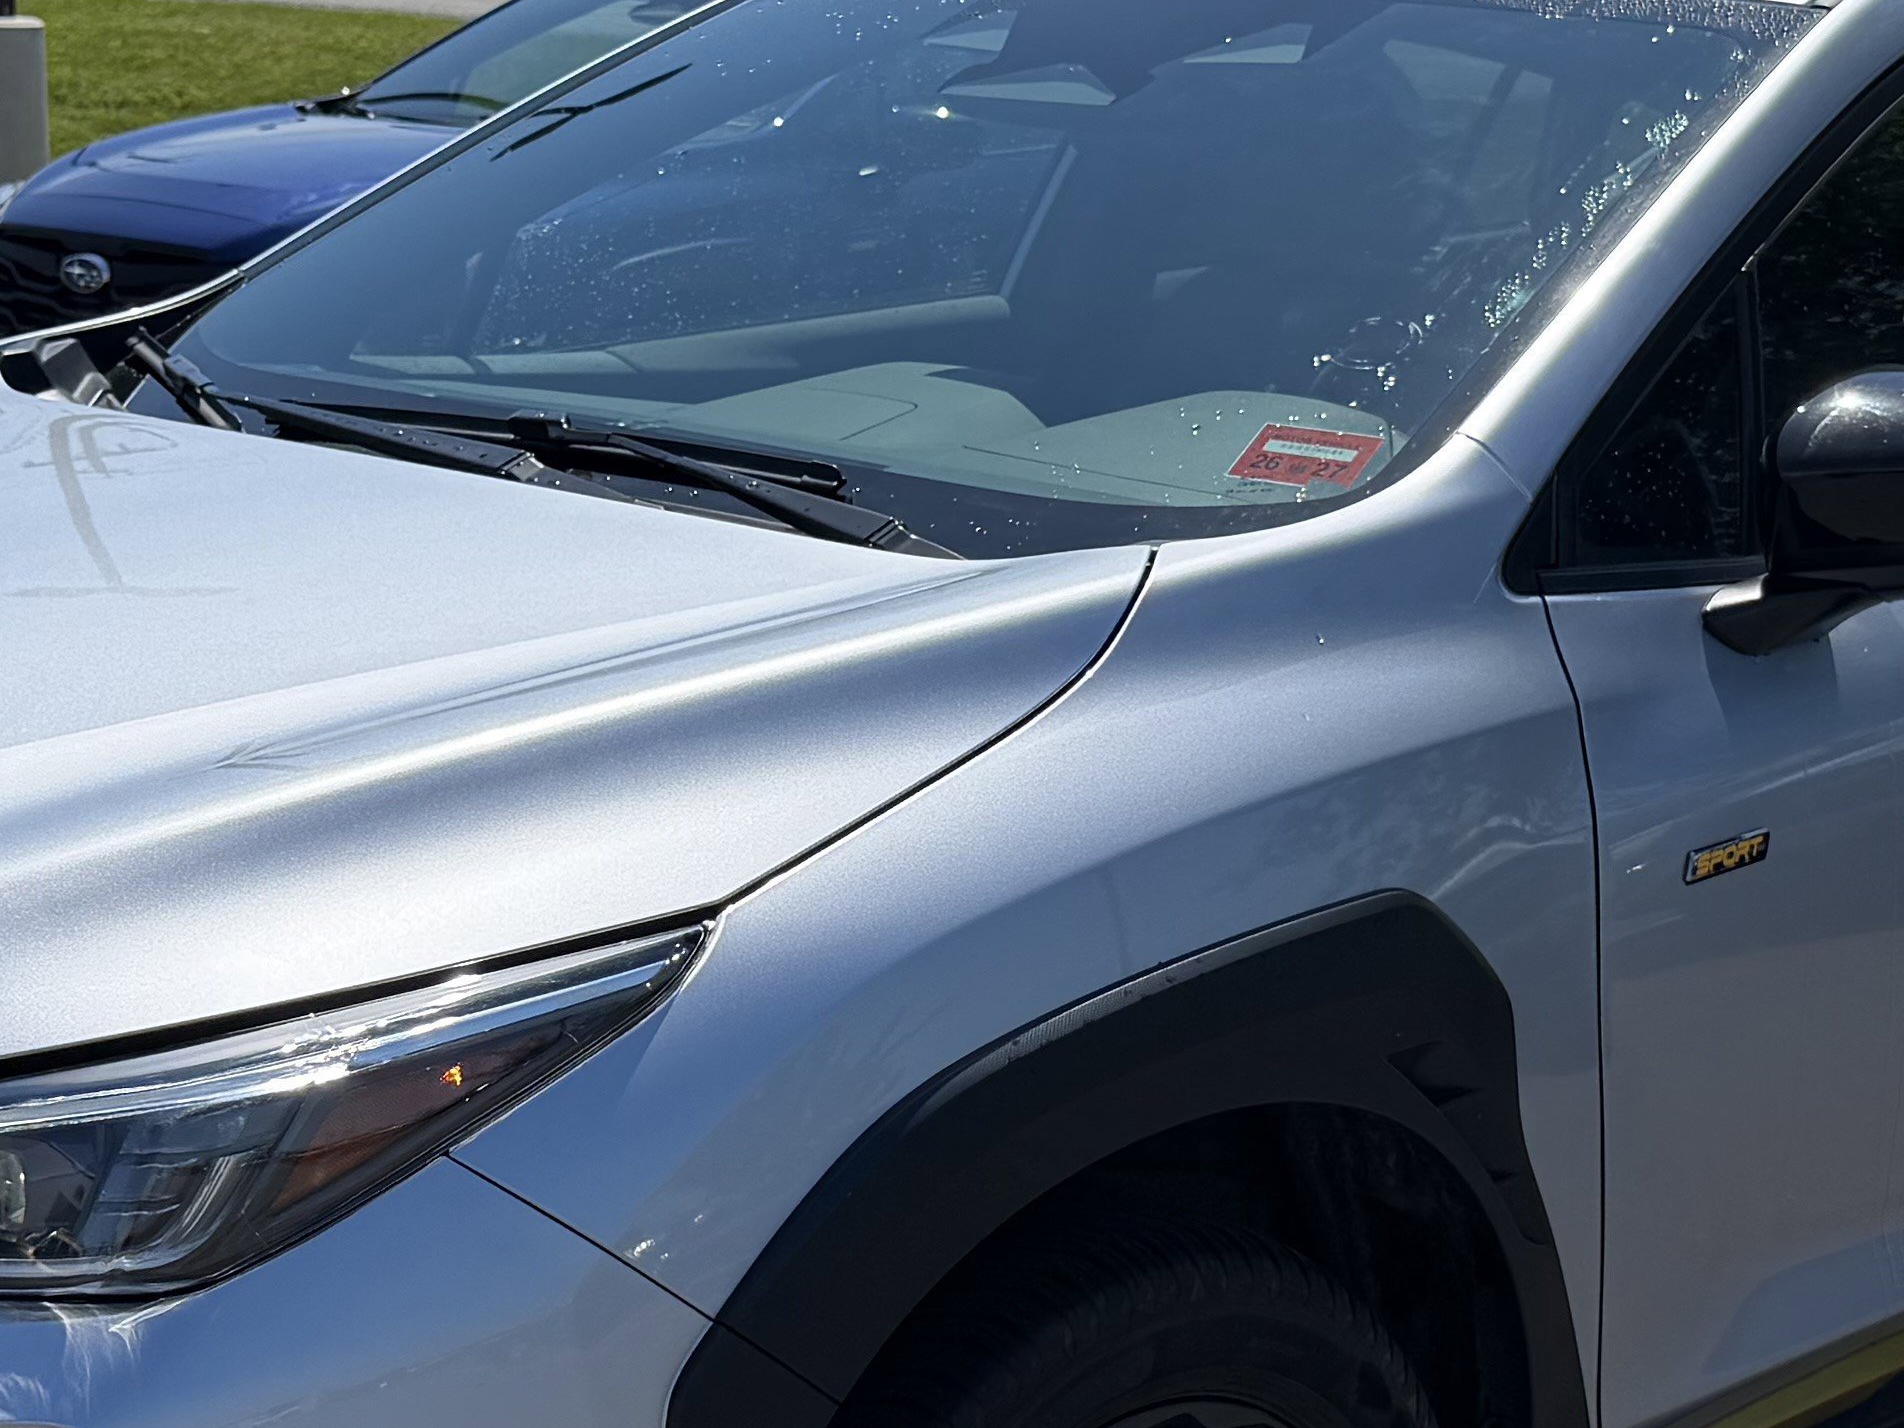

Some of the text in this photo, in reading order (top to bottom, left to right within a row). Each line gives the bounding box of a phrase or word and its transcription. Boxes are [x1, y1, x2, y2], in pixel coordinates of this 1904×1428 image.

[1250, 453, 1283, 470] 26
[1311, 461, 1349, 478] 27
[1694, 835, 1765, 877] SPORT
